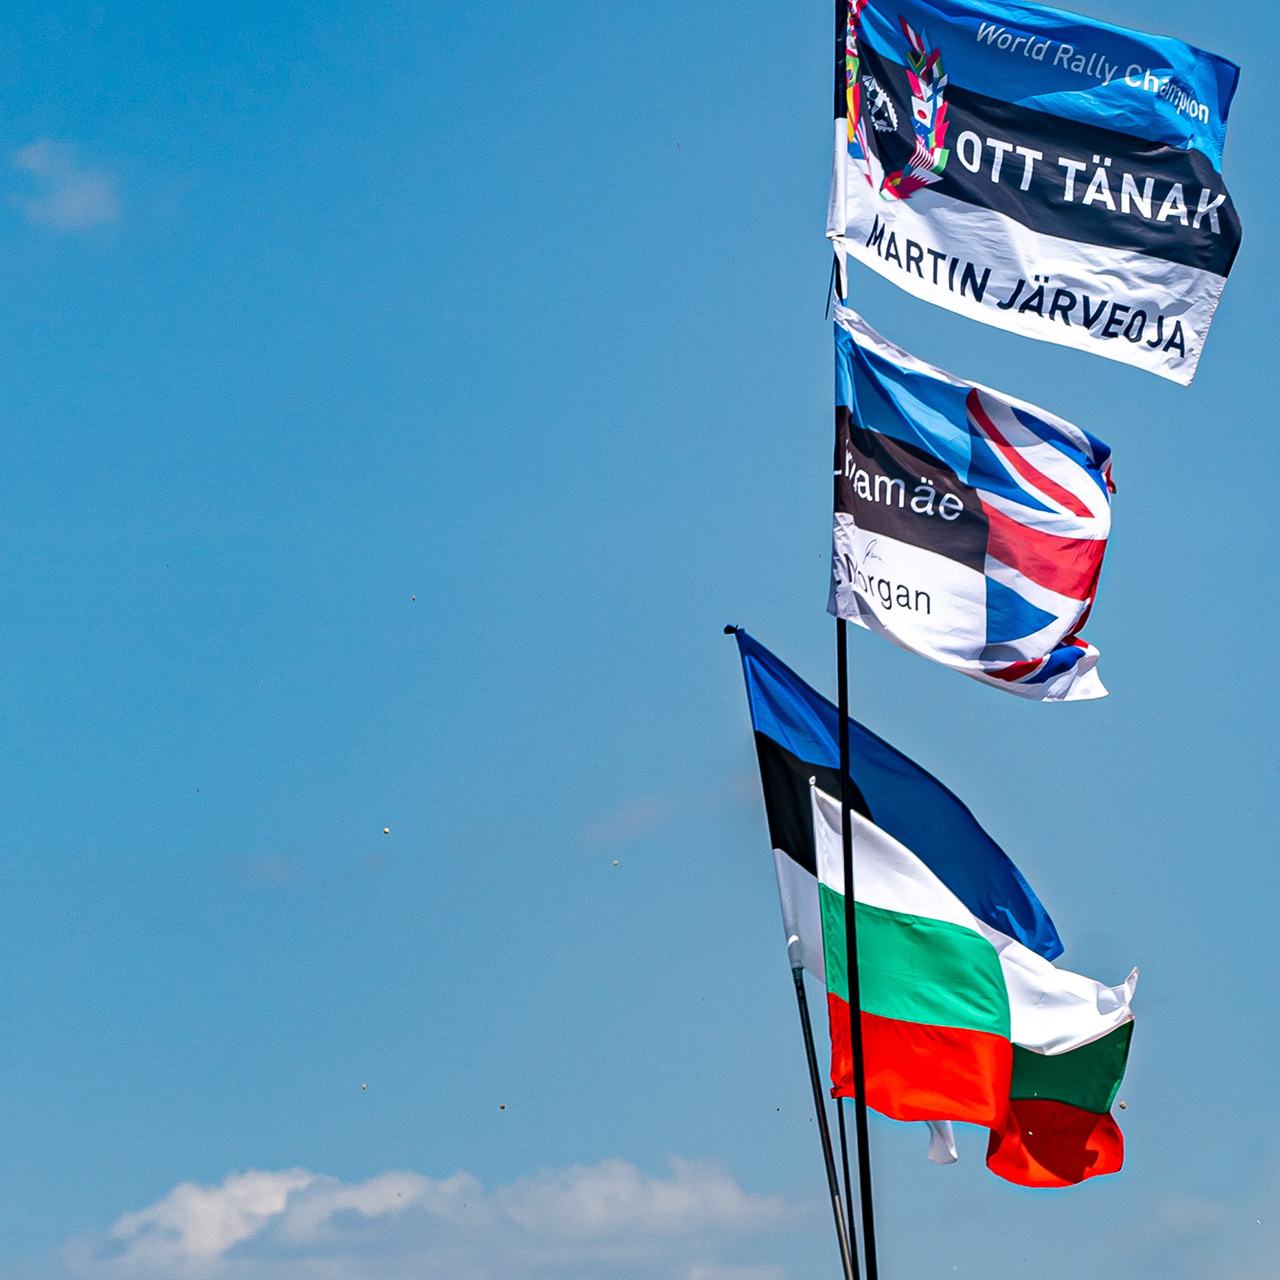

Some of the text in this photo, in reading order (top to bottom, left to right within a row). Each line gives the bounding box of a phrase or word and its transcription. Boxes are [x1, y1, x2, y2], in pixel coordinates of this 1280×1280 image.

[976, 22, 1210, 124] World Rally Champion
[956, 130, 1227, 234] OTT TÄNAK
[865, 214, 1186, 358] MARTIN JÄRVEOJA
